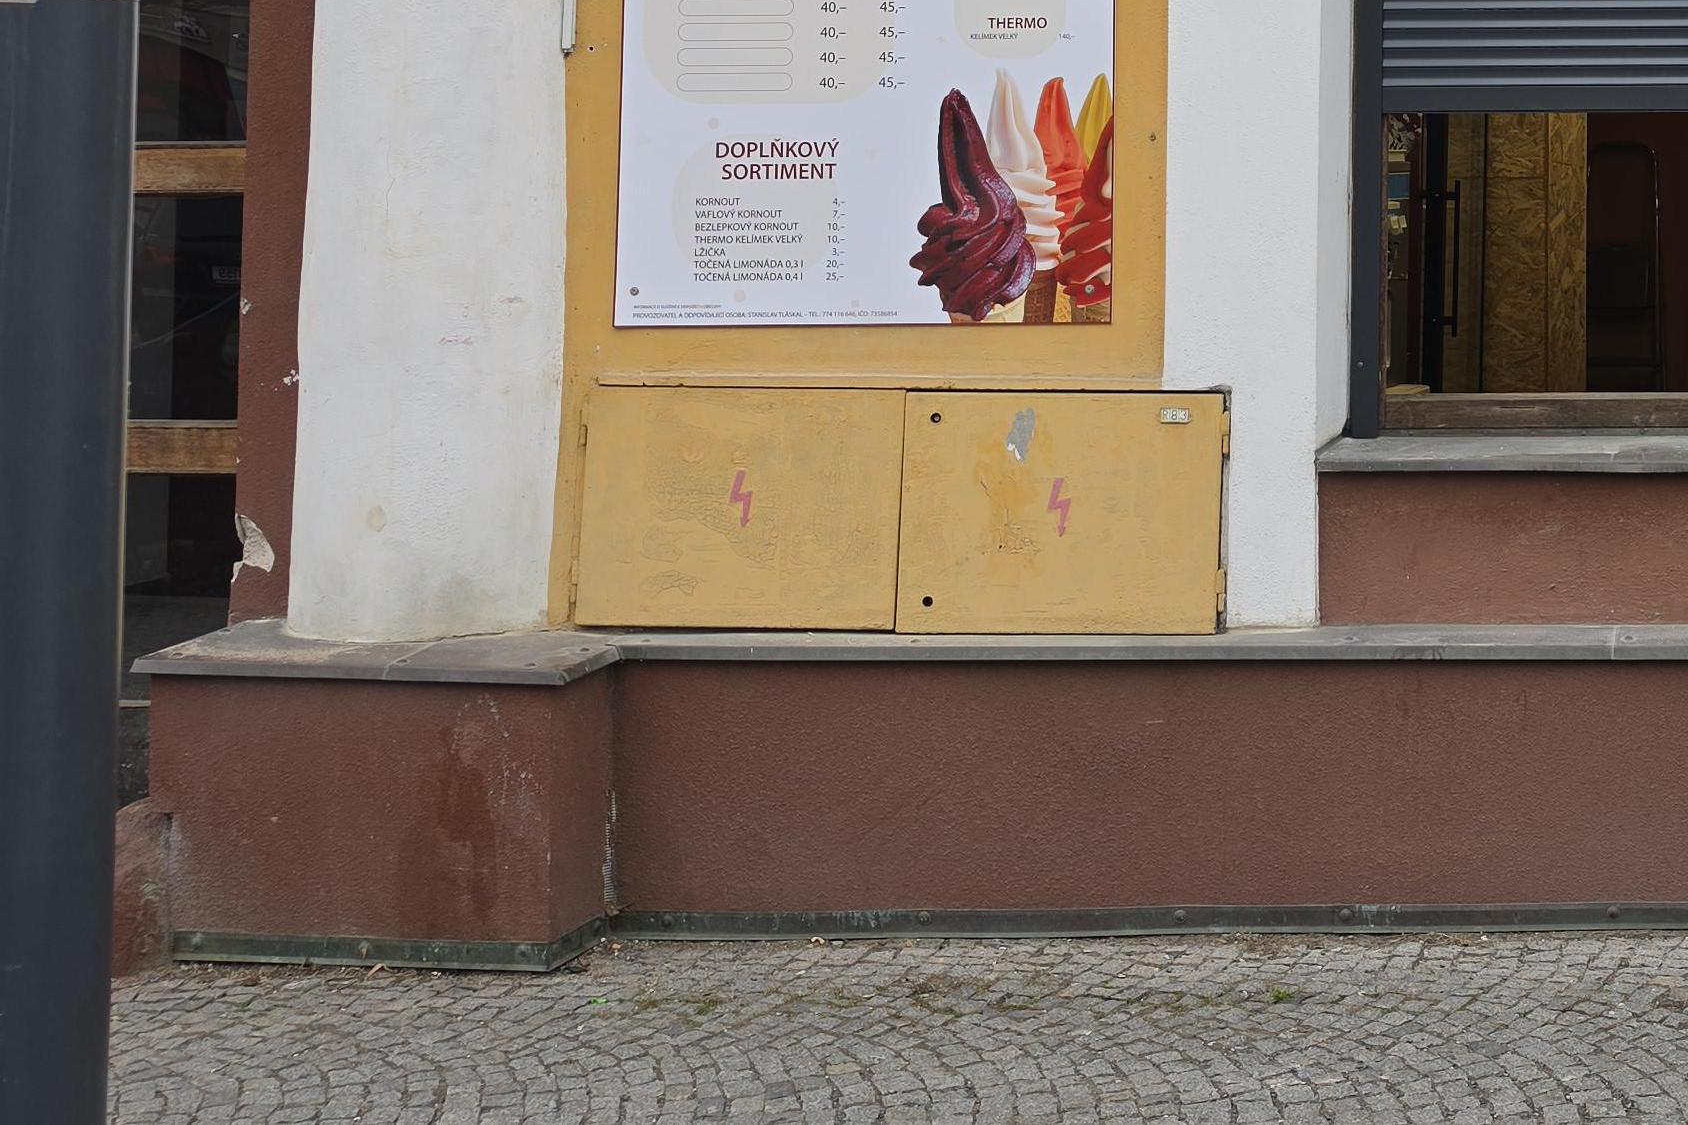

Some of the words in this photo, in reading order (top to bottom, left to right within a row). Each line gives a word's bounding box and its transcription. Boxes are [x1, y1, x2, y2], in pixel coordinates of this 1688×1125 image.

[988, 17, 1048, 29] THERMO
[715, 138, 840, 158] DOPLŇKOVÝ
[721, 163, 837, 180] SORTIMENT
[695, 197, 741, 206] KORNOUT
[695, 208, 736, 219] VAFLOVÝ
[737, 209, 783, 219] KORNOUT
[695, 221, 752, 232] BEZLEPKOVÝ
[754, 221, 799, 231] KORNOUT
[694, 234, 734, 244] THERMO
[735, 233, 774, 244] KELÍMEK
[775, 233, 803, 244] VELKÝ
[694, 247, 726, 257] LŽIČKA
[694, 259, 732, 270] TOČENÁ
[733, 259, 784, 269] LIMONÁDA
[785, 260, 799, 270] 0,3
[693, 272, 731, 282] TOČENÁ
[733, 272, 784, 282] LIMONÁDA
[785, 272, 799, 283] 0,4
[1162, 409, 1187, 421] R83
